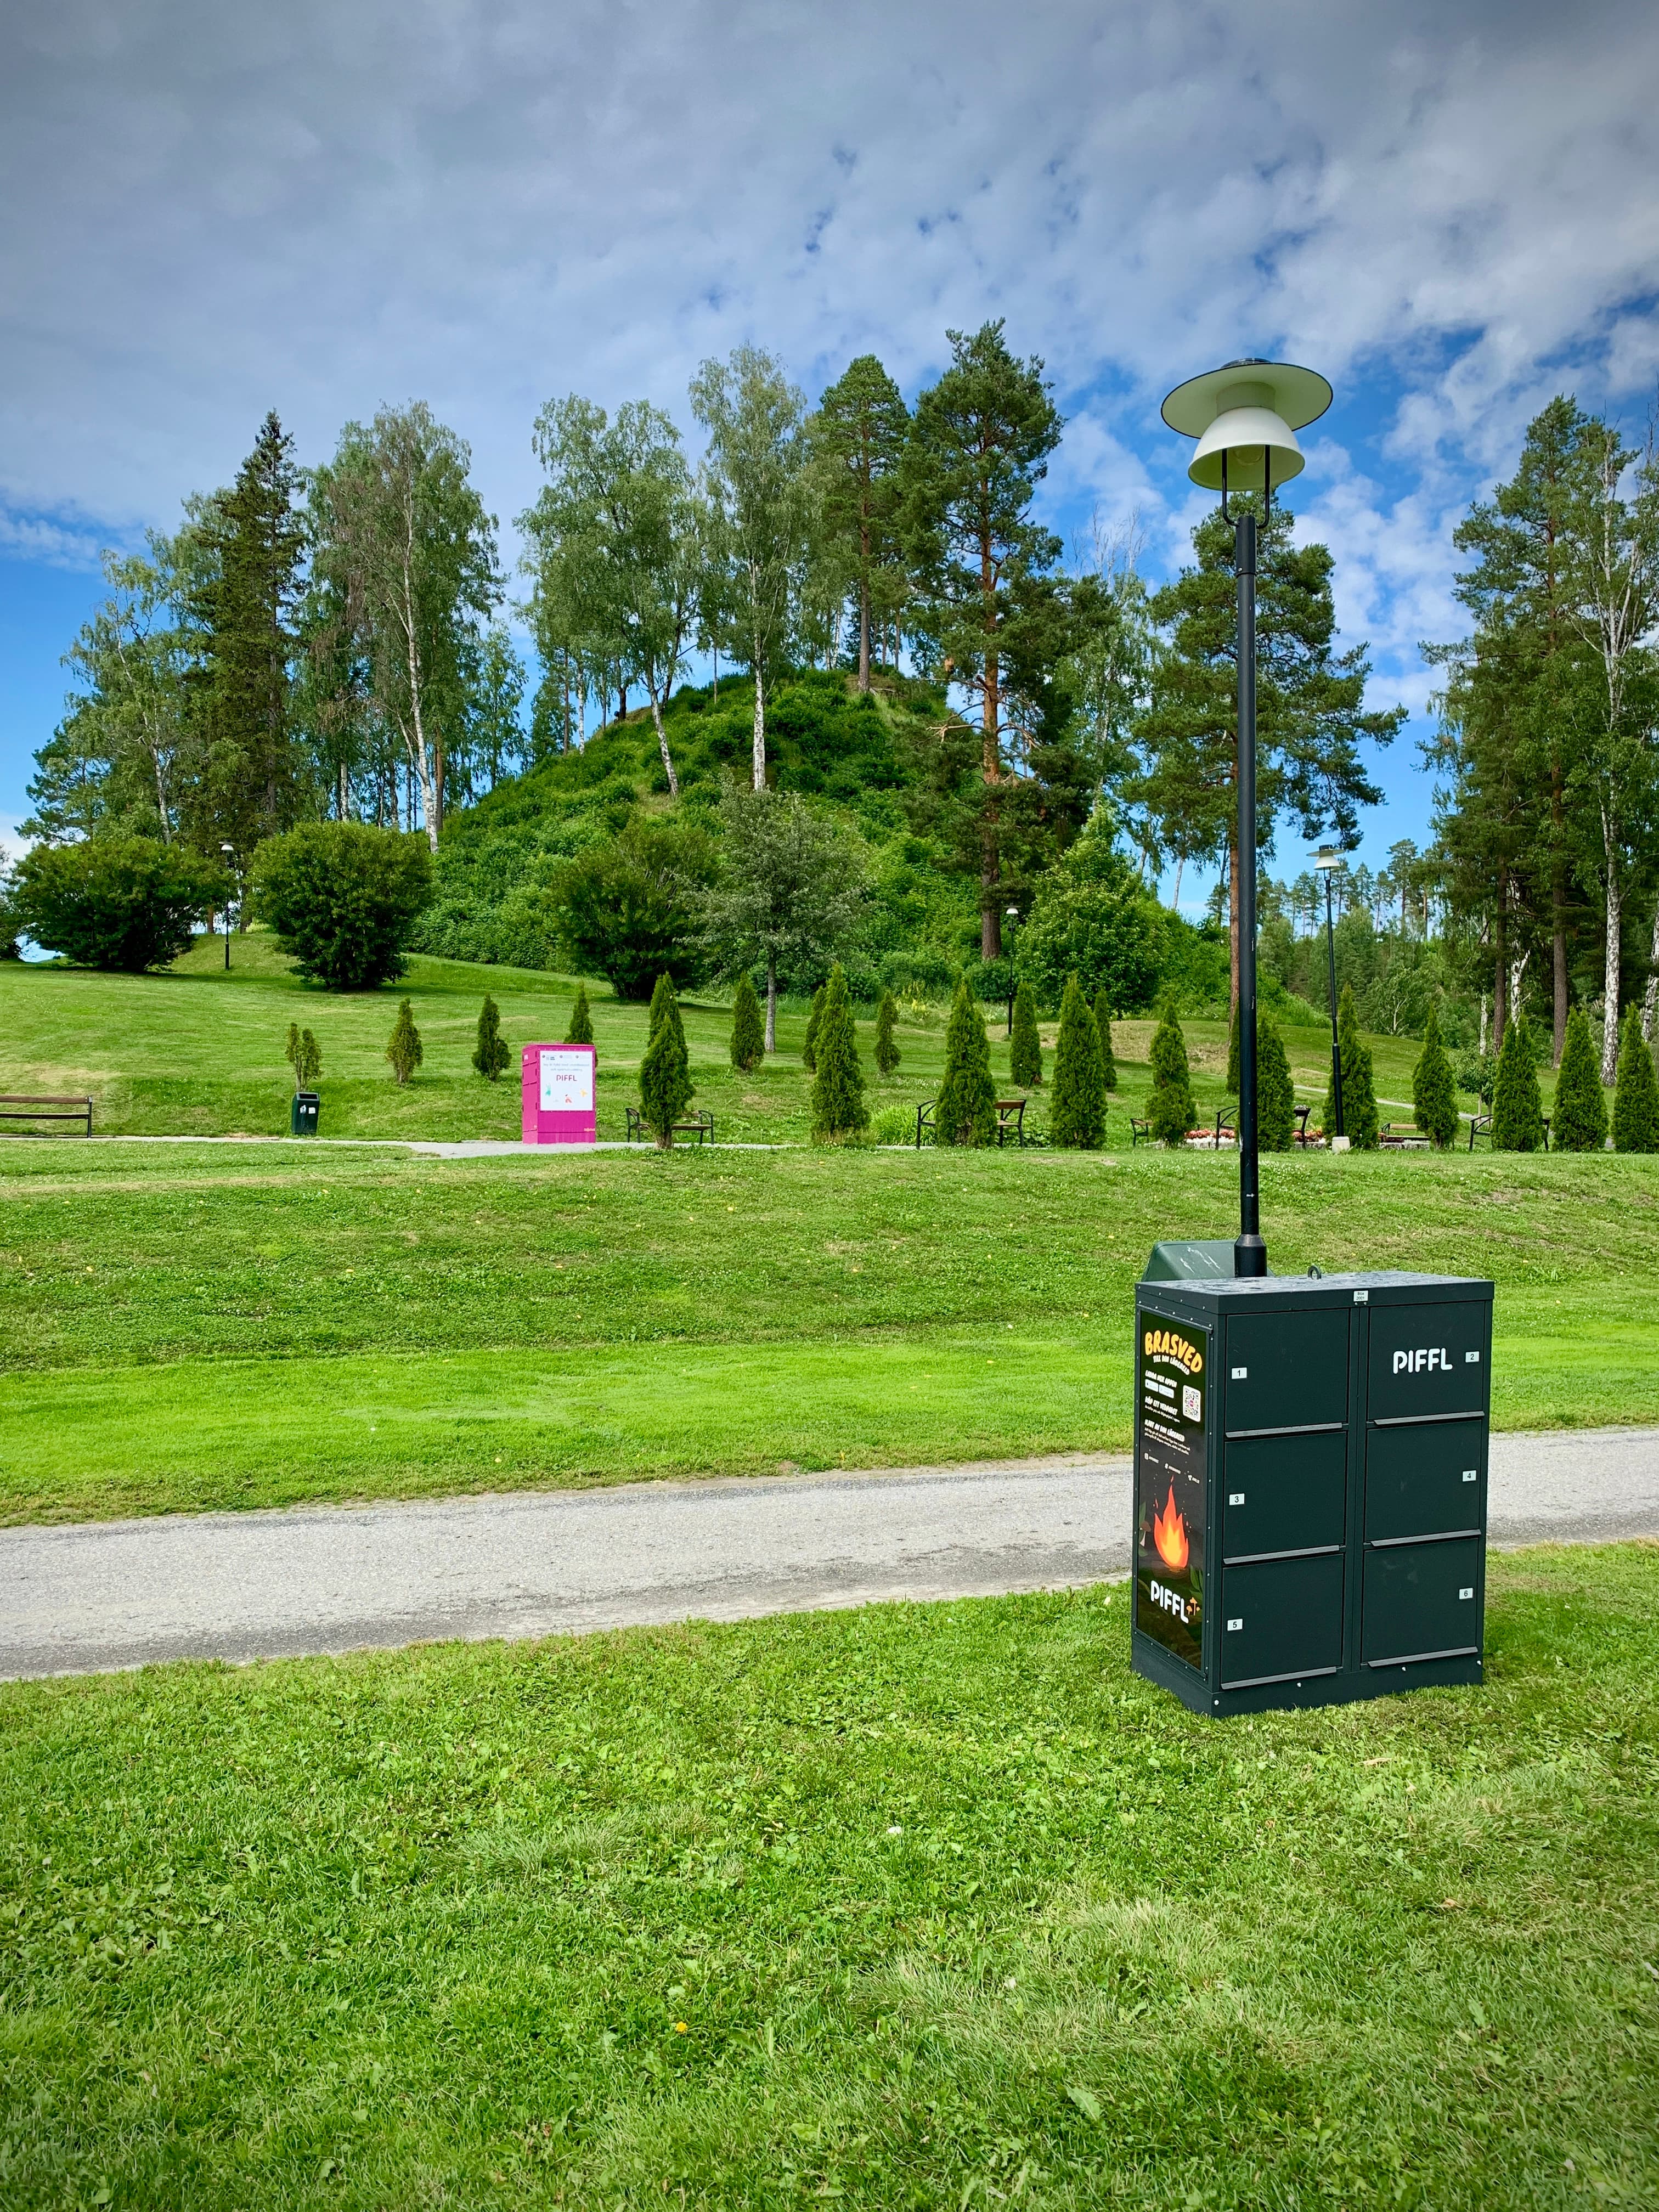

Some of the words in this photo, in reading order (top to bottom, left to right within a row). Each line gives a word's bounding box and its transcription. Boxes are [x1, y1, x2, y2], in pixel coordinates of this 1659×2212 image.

[1145, 1330, 1203, 1373] BRASVED
[1393, 1347, 1453, 1374] PIFFL
[1151, 1580, 1189, 1624] PIFFL
